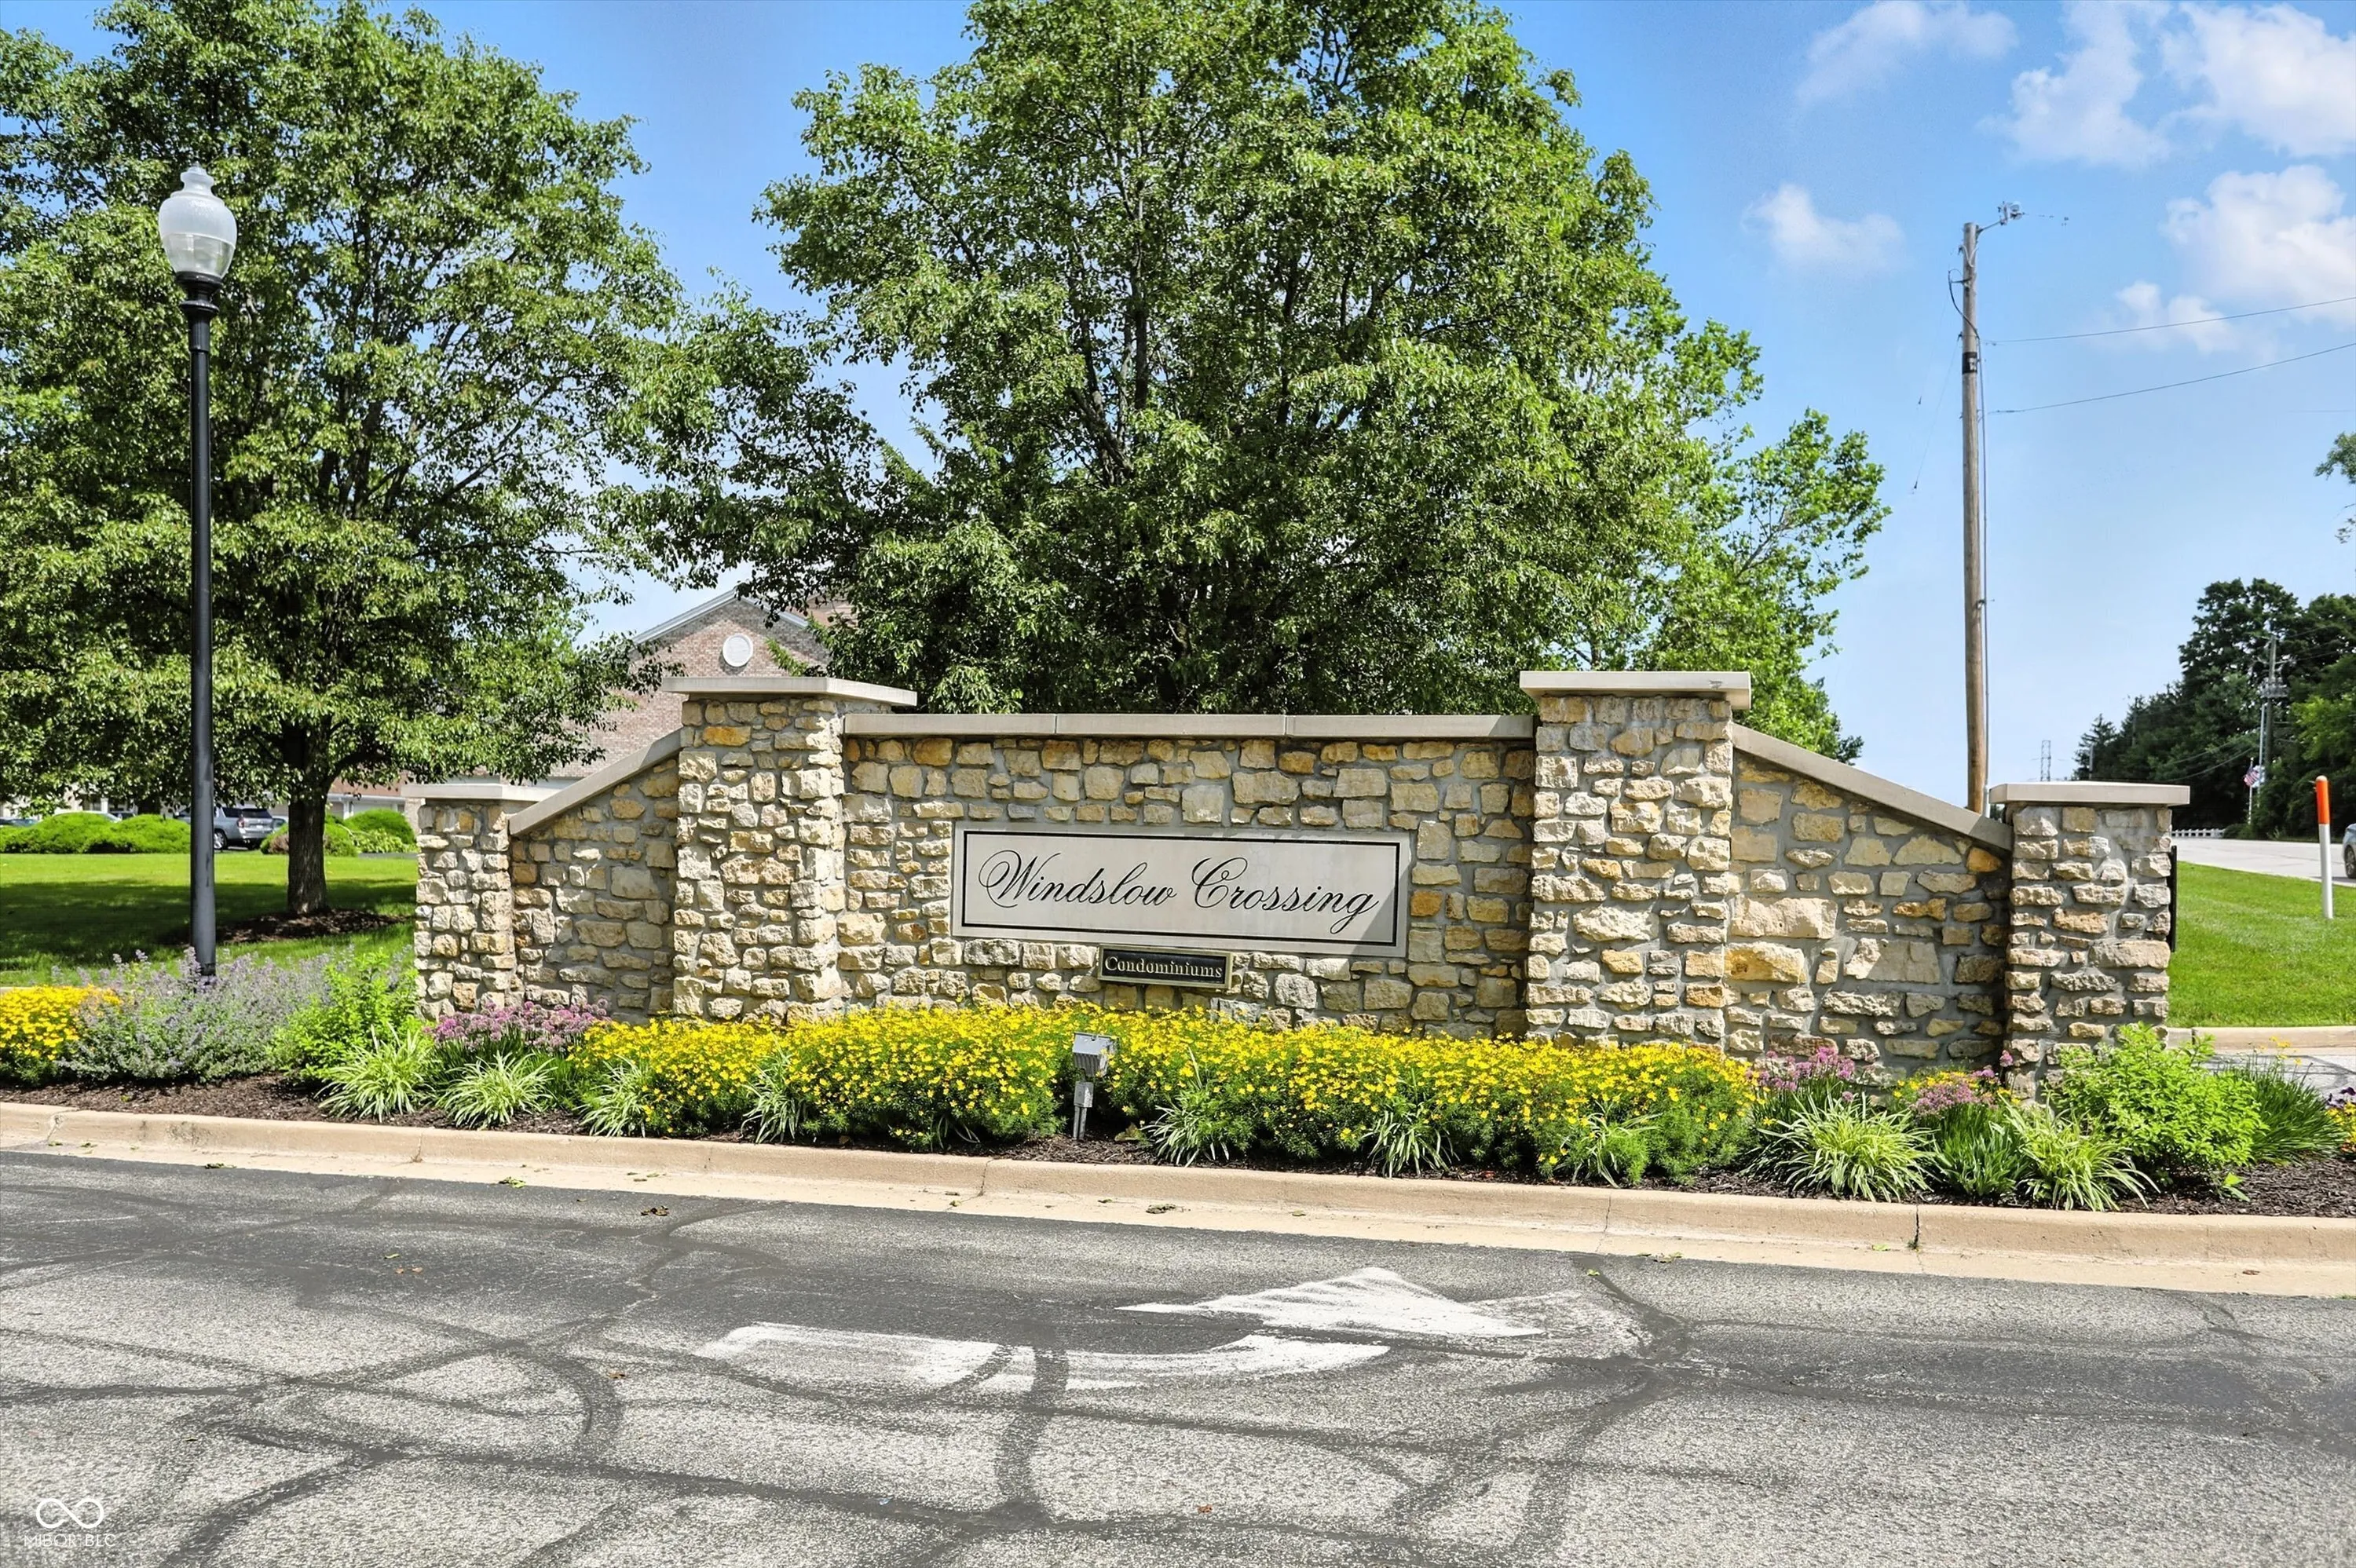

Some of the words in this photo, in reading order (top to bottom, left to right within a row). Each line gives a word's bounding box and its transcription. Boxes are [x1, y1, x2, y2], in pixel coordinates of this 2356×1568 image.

[979, 850, 1176, 908] Windslow
[1191, 857, 1380, 934] Crossing
[1104, 956, 1223, 978] Condominiums
